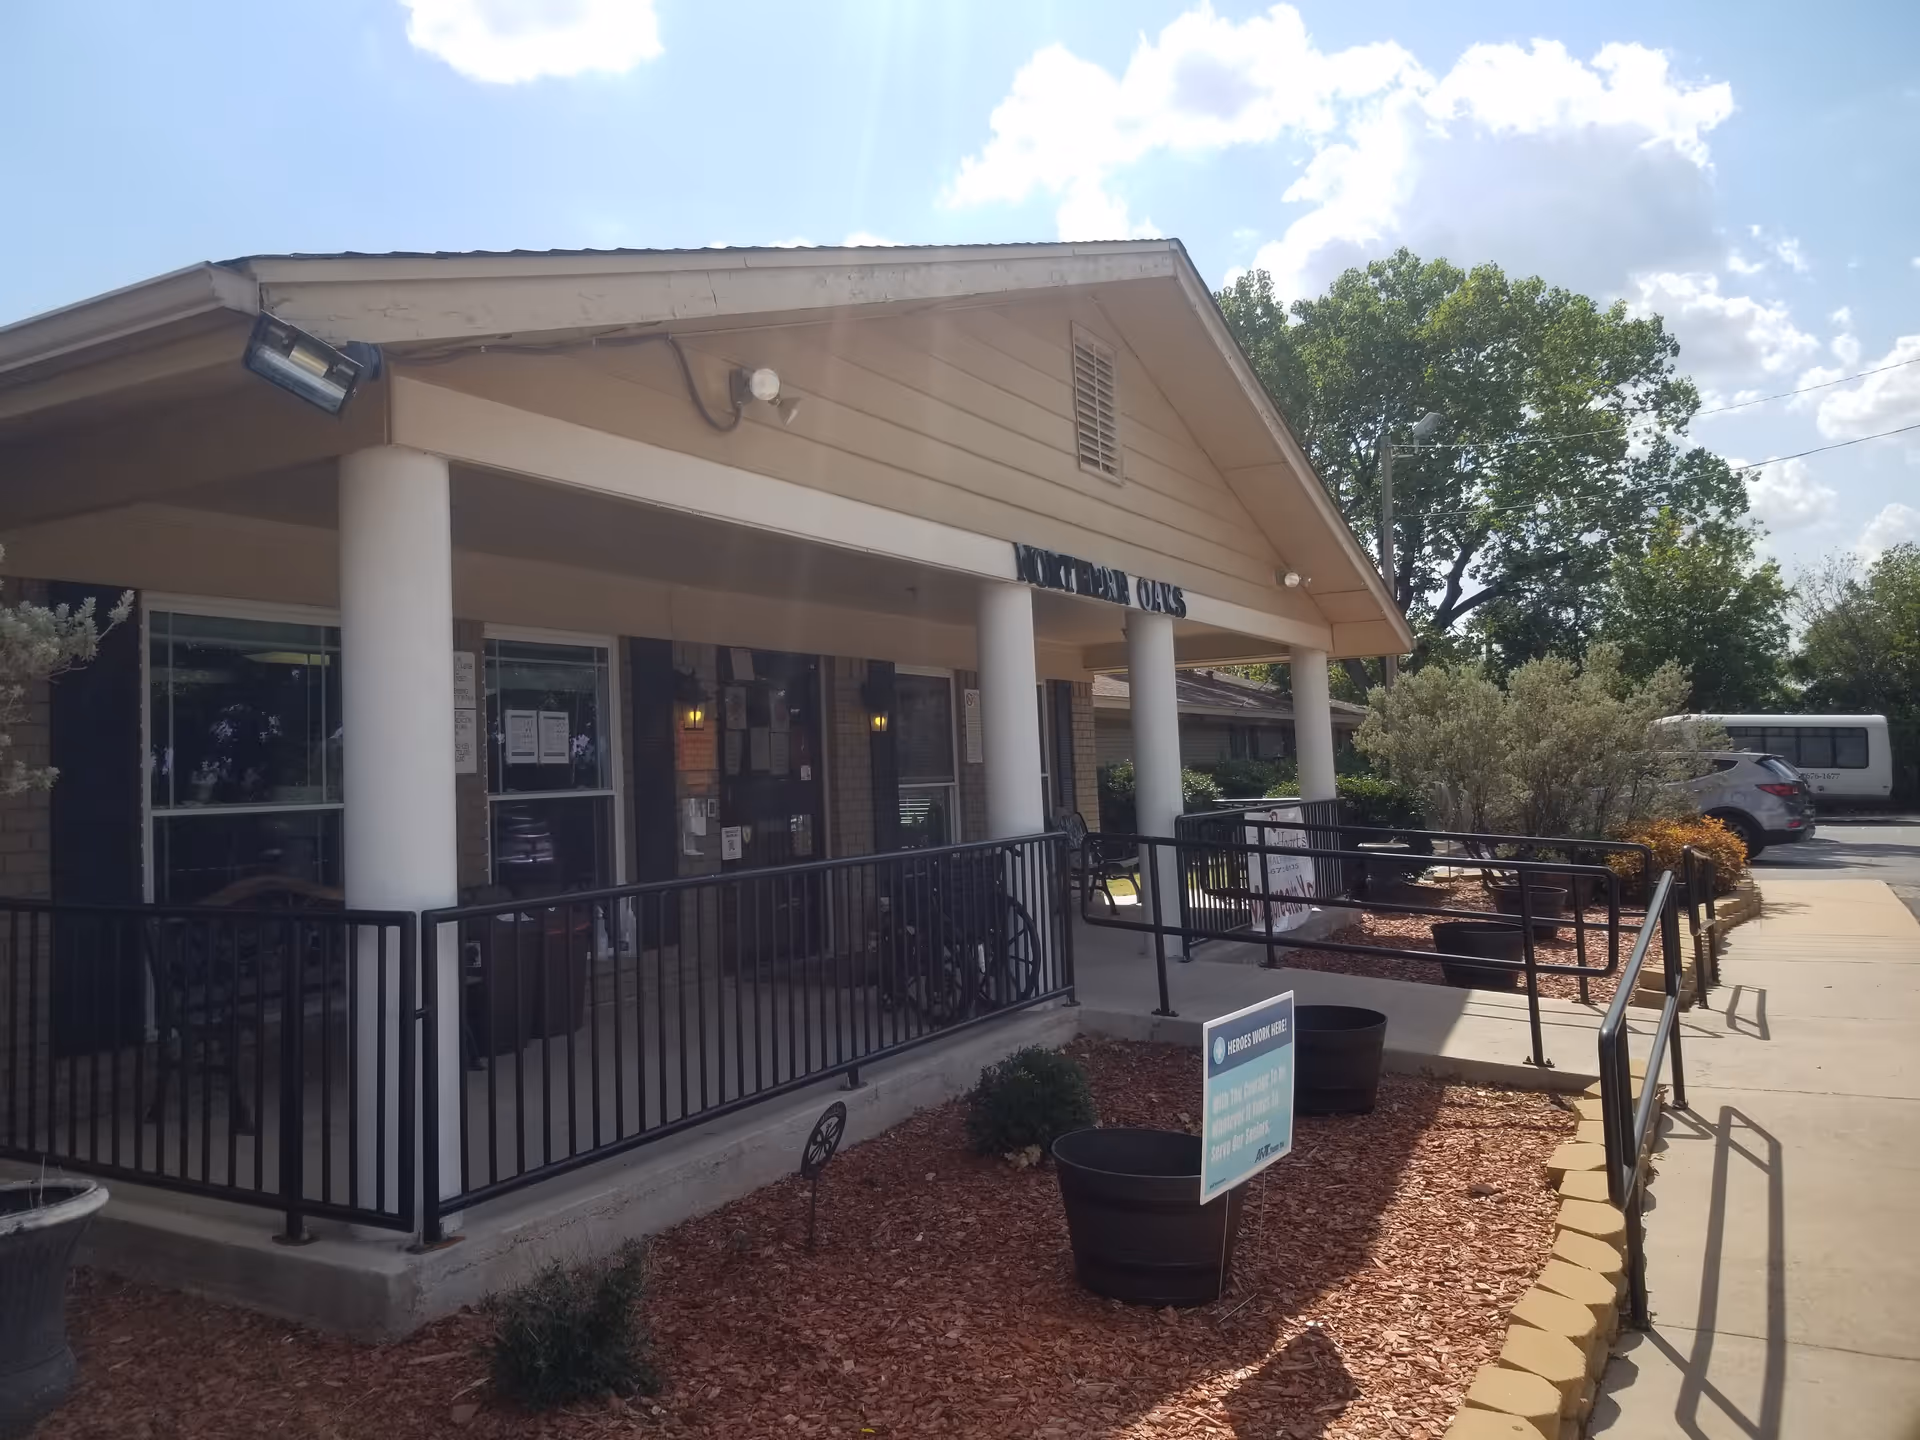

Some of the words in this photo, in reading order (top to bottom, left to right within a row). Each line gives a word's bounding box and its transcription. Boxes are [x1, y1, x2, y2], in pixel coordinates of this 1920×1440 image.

[1136, 576, 1187, 619] OAKS
[1227, 1033, 1252, 1056] HEROES
[1252, 1025, 1271, 1045] WORK
[1270, 1018, 1288, 1037] HERE!
